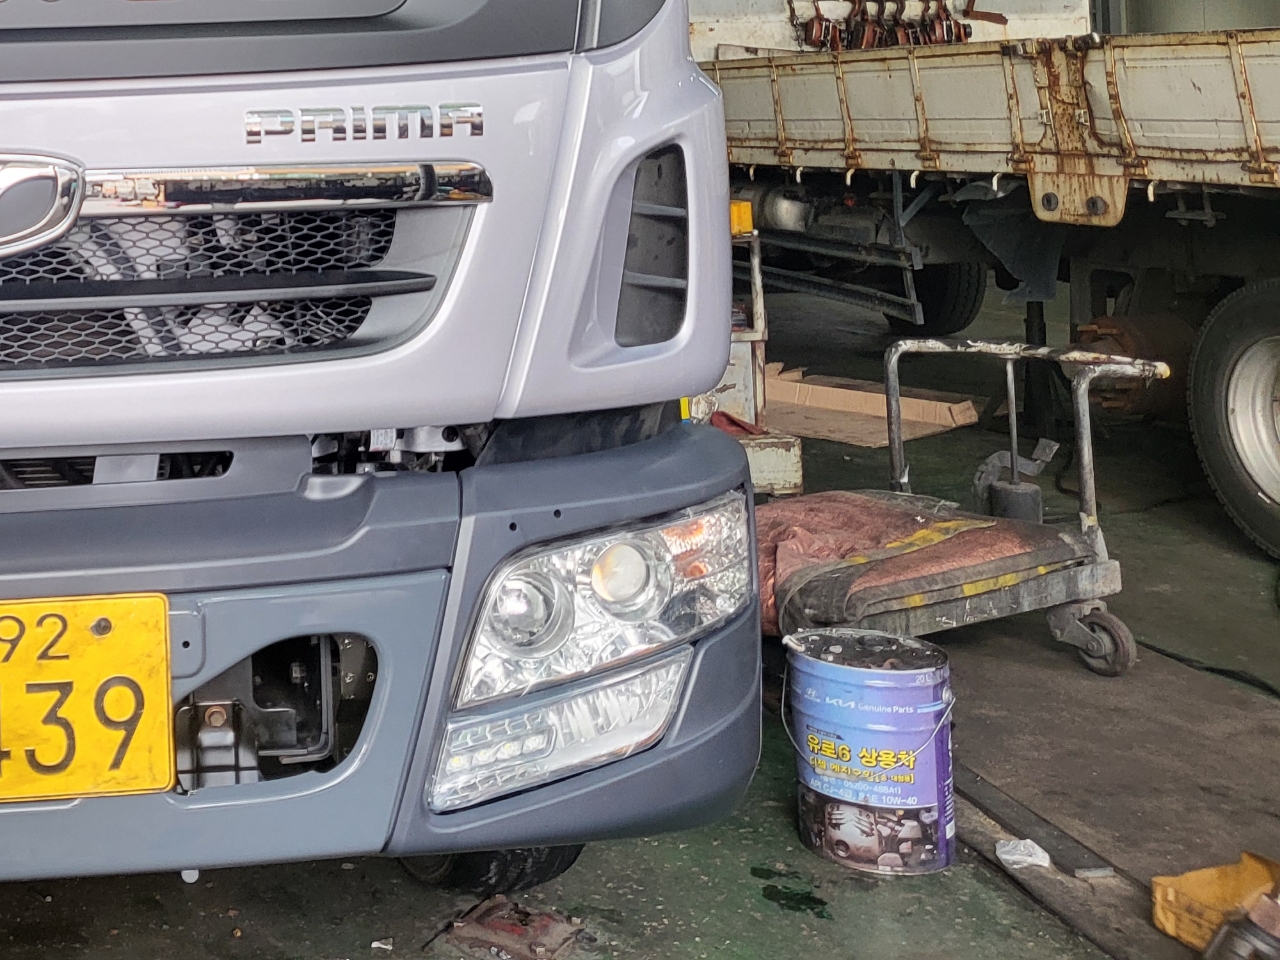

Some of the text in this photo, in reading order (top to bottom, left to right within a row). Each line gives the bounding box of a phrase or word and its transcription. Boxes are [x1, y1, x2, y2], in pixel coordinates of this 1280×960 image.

[244, 101, 483, 144] PRIMA
[857, 703, 892, 714] Genuine
[892, 705, 915, 714] Parts
[806, 733, 916, 770] 유로6 상용차
[881, 795, 918, 806] 10W-40
